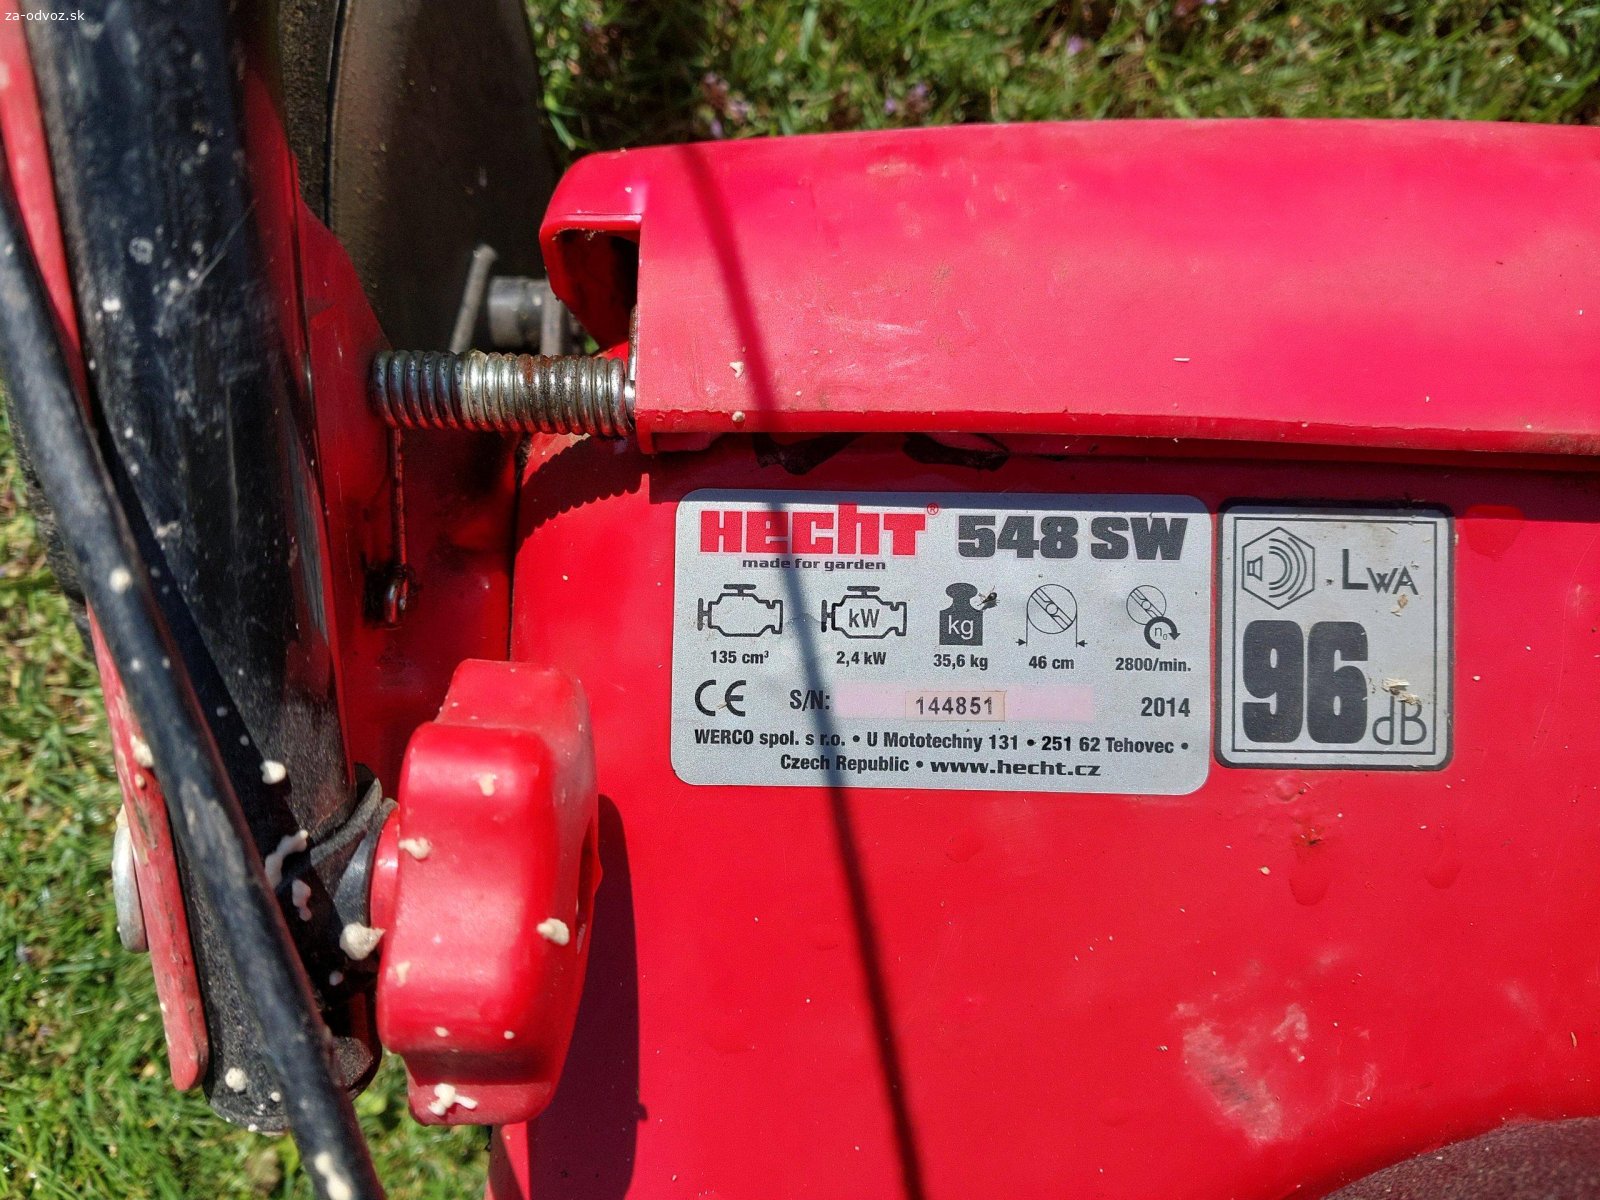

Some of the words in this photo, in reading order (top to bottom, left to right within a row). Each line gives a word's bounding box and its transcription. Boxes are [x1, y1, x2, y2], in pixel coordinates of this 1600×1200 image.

[957, 515, 1079, 559] 548
[1090, 517, 1188, 561] SW
[742, 558, 791, 569] made
[795, 558, 820, 569] for
[824, 560, 886, 572] garden
[849, 609, 880, 628] kW
[948, 617, 974, 640] kg
[710, 651, 737, 664] 135
[836, 651, 860, 667] 2,4
[864, 652, 886, 666] kW
[933, 654, 966, 670] 35,6
[970, 654, 988, 671] kg
[1028, 656, 1047, 669] 46
[1051, 657, 1075, 670] cm
[1115, 658, 1192, 672] 2800/min.
[1242, 620, 1368, 744] 96
[1372, 697, 1427, 745] dB
[694, 680, 747, 717] CE
[789, 690, 830, 711] S/N:
[915, 697, 992, 716] 144851
[1141, 697, 1191, 718] 2014
[694, 729, 754, 745] WERCO
[759, 731, 800, 748] spol.
[805, 735, 815, 746] s
[819, 733, 846, 747] r.o.
[867, 733, 878, 747] U
[988, 735, 1018, 750] 131
[1041, 736, 1072, 751] 251
[1079, 737, 1100, 752] 62
[1105, 737, 1174, 753] Tehovec
[780, 754, 830, 770] Czech
[835, 756, 910, 774] Republic
[930, 759, 1101, 777] www.hecht.cz
